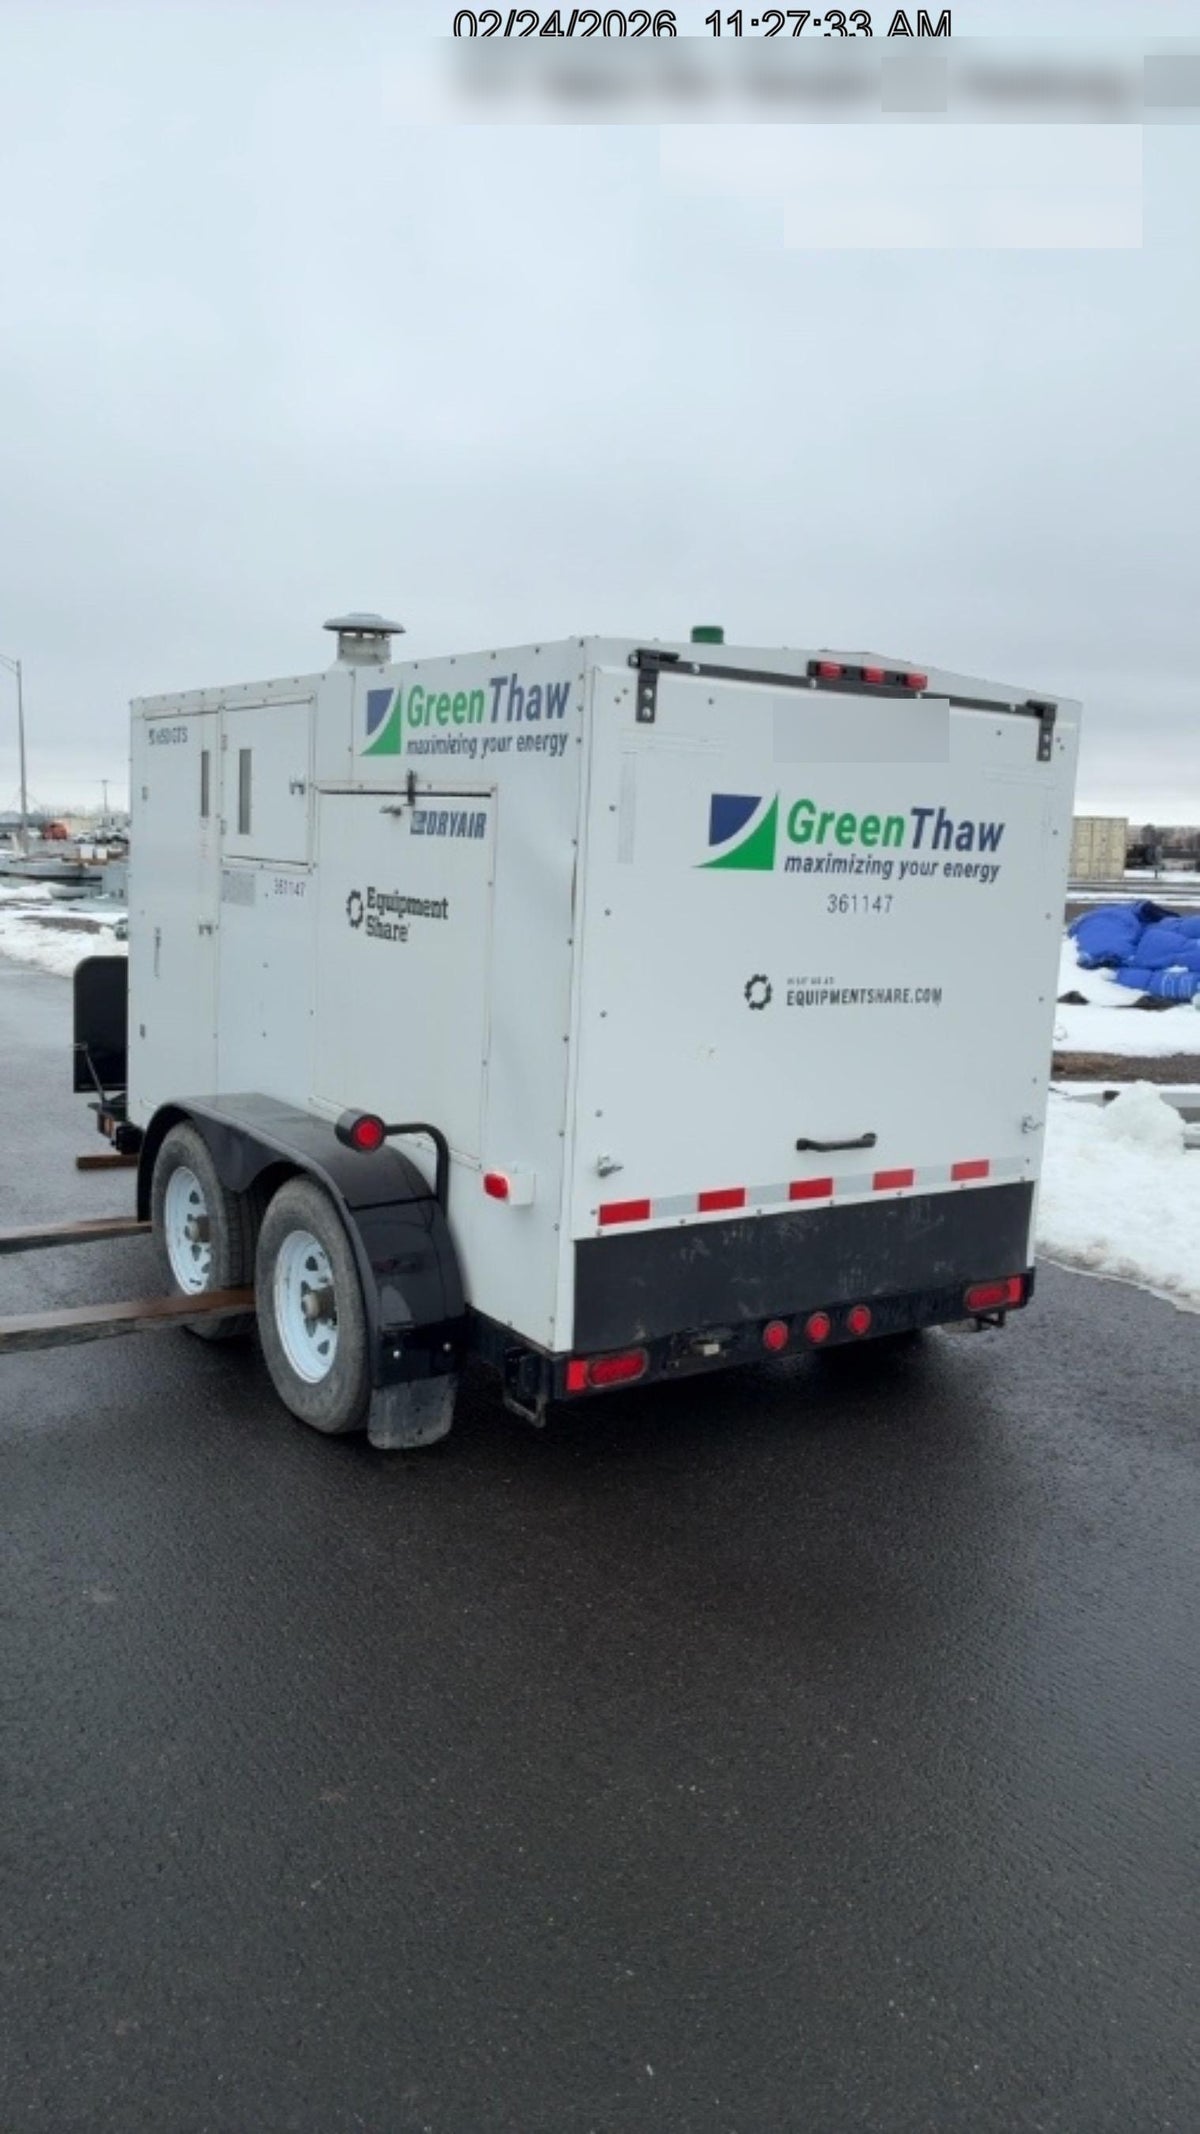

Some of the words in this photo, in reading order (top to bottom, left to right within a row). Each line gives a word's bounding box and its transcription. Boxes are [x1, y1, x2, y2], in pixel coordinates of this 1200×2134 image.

[406, 732, 478, 759] maximizing
[481, 735, 513, 759] your
[516, 732, 569, 757] energy
[426, 811, 487, 839] DRYAIR
[784, 853, 894, 880] maximizing
[899, 859, 939, 880] your
[943, 861, 1002, 884] energy
[366, 886, 449, 920] Equipment
[827, 893, 894, 914] 361147
[366, 914, 408, 942] Share
[787, 987, 943, 1007] EQUIPMENTSHARE.COM
